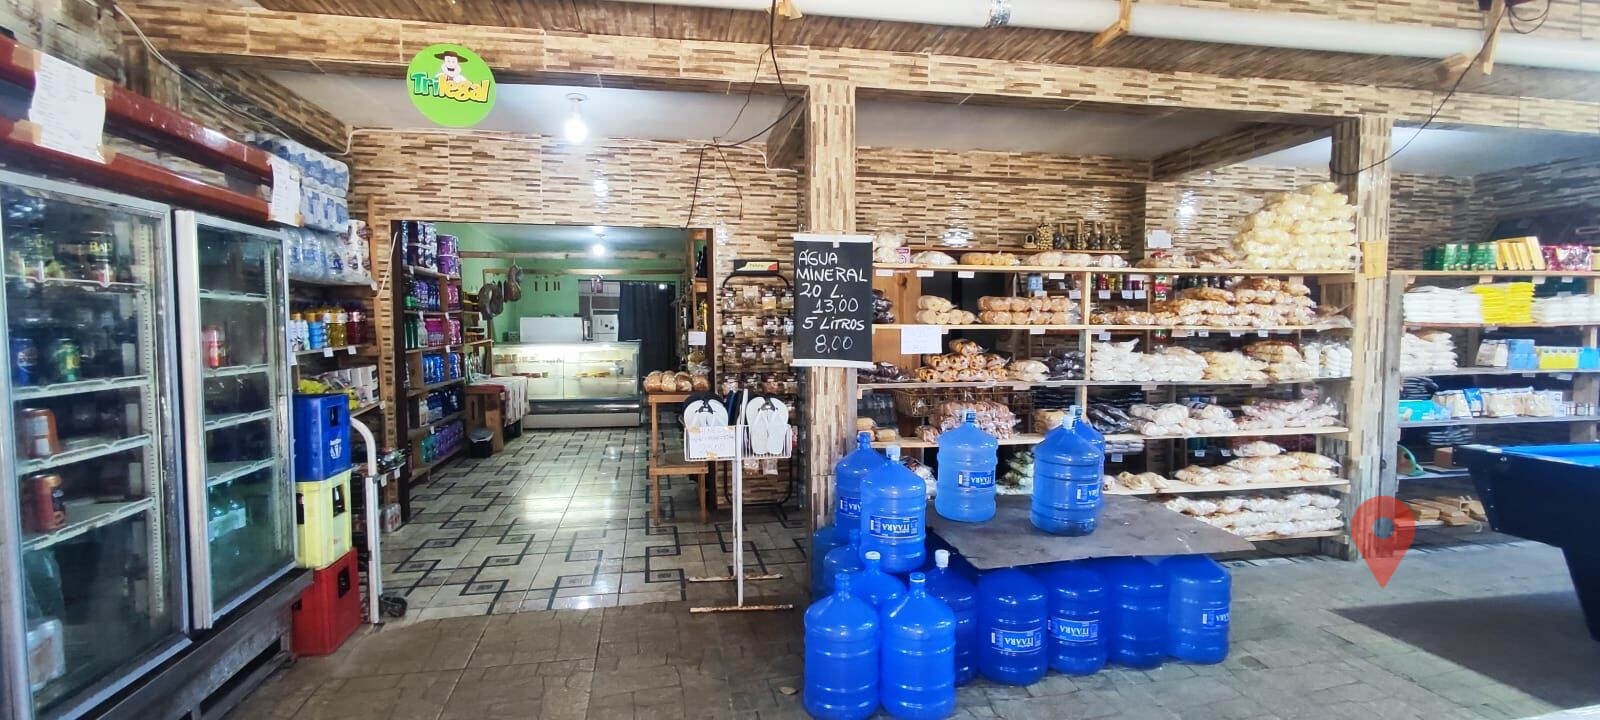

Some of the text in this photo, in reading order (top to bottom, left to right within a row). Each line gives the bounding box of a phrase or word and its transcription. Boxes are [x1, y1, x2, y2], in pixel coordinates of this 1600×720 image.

[798, 249, 838, 266] ÁGUA
[796, 267, 868, 282] MINERAL
[800, 283, 821, 298] 20
[812, 298, 859, 314] 13,00
[802, 317, 818, 330] 5
[815, 334, 853, 354] 8,00
